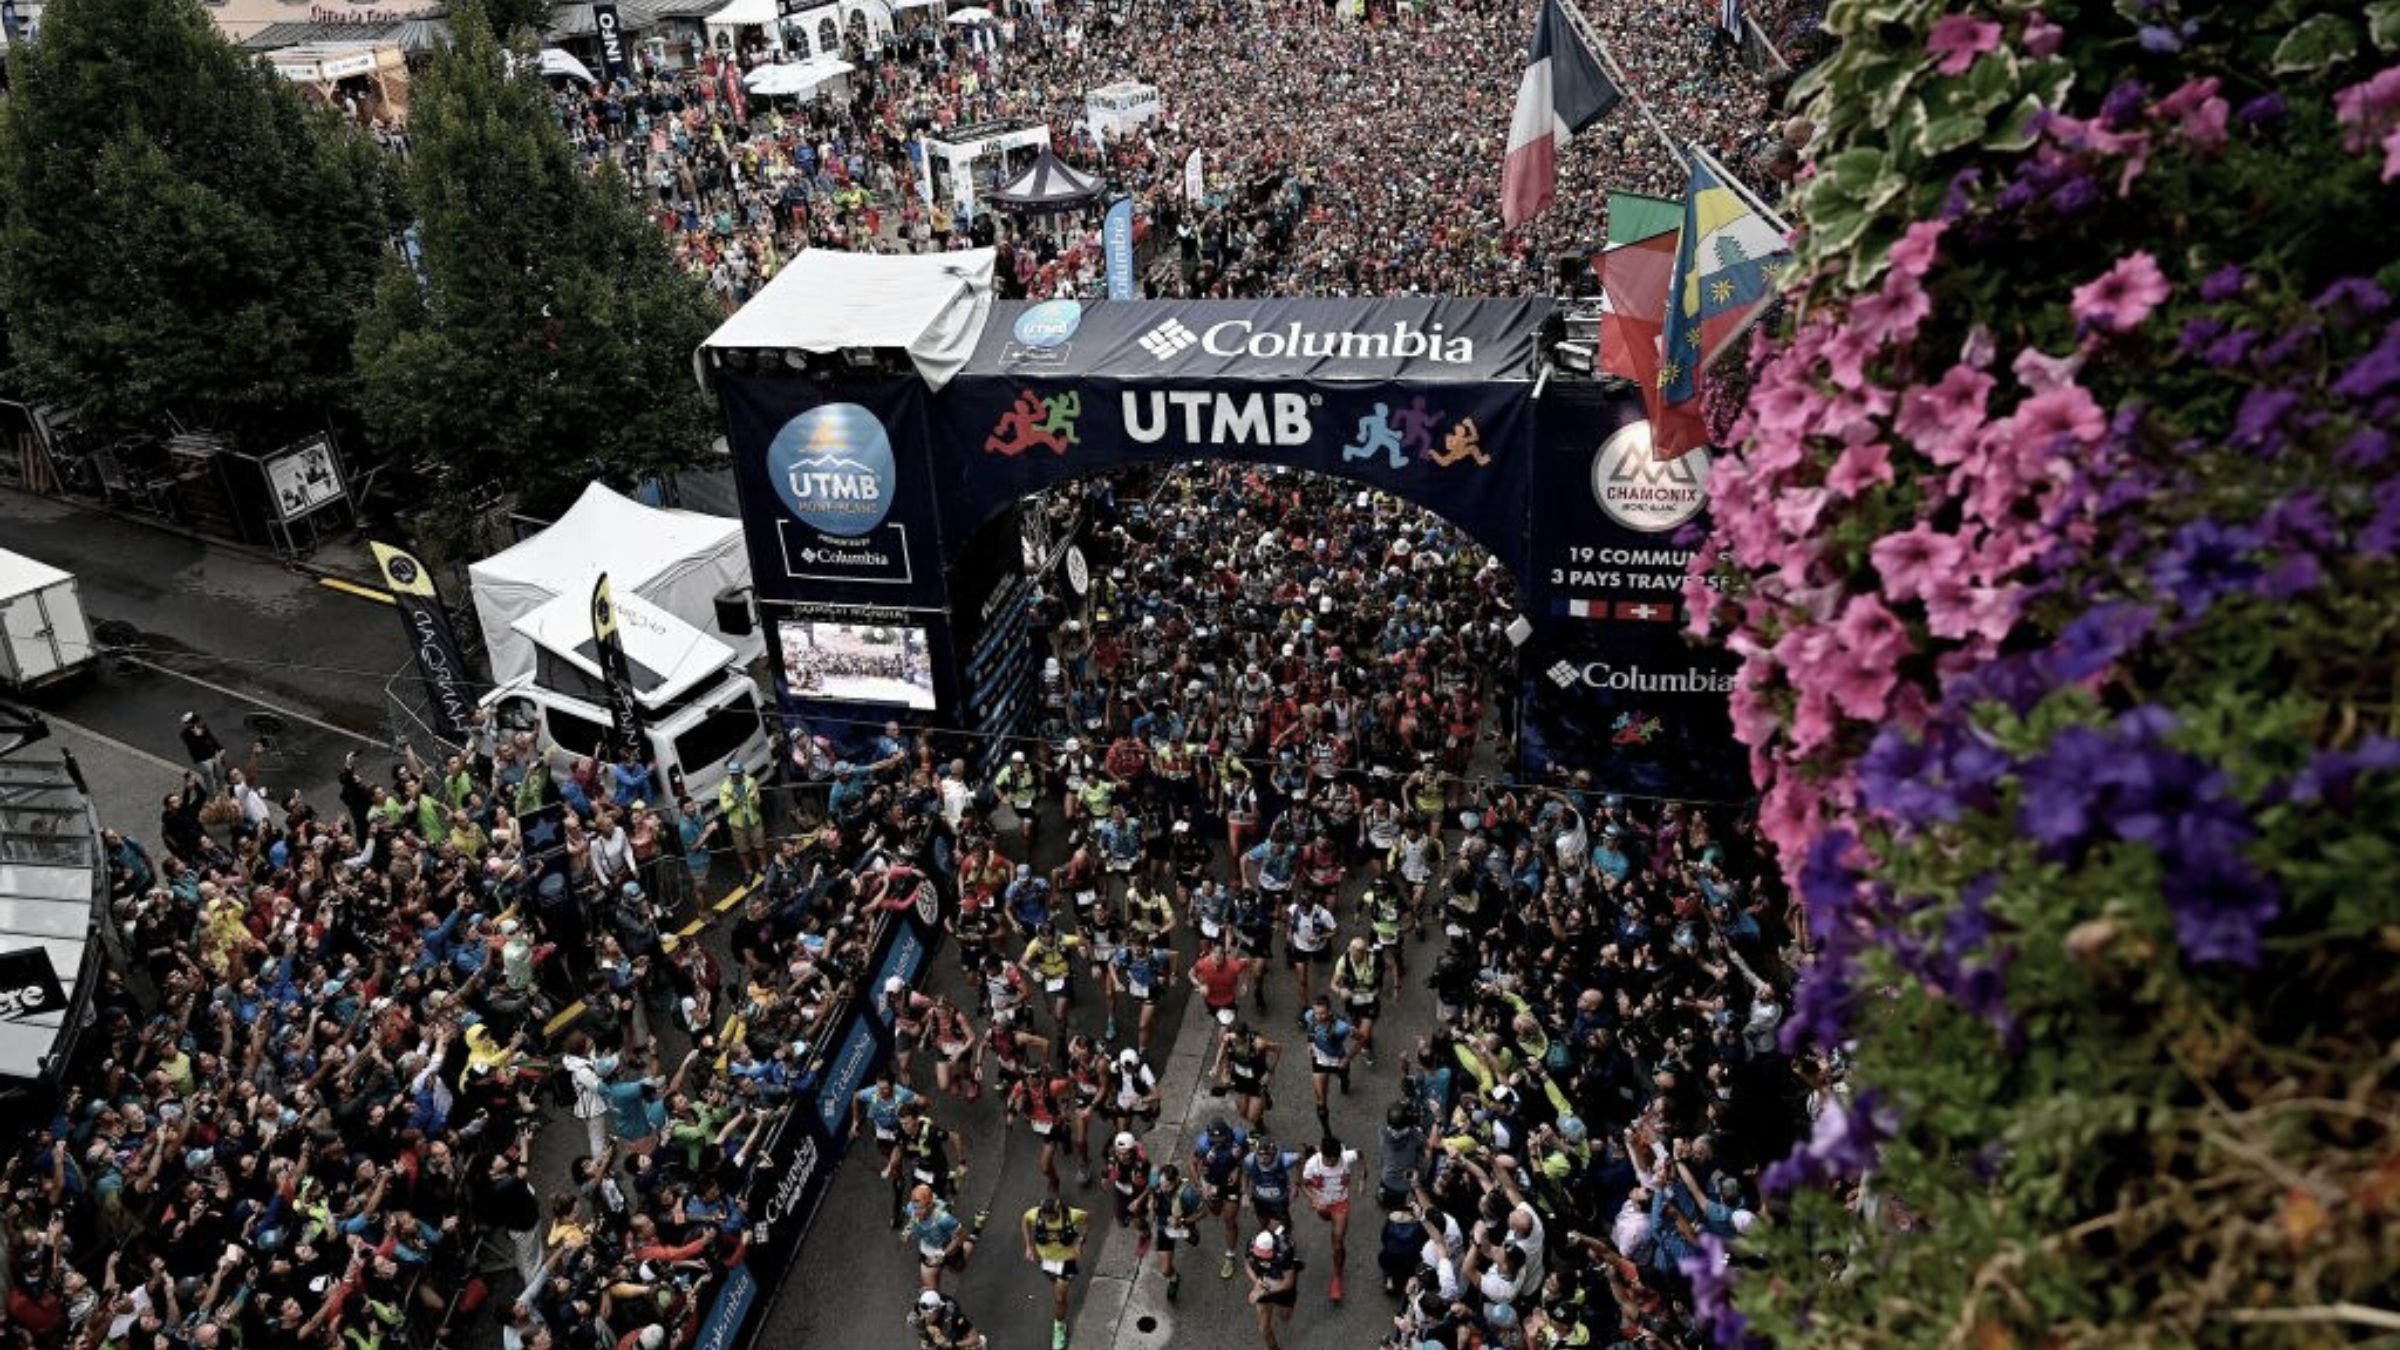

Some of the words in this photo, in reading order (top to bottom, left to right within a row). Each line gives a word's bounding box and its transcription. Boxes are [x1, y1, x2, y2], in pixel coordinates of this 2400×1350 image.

[599, 12, 623, 63] INFO
[1201, 319, 1473, 363] Columbia
[788, 472, 880, 501] UTMB
[1606, 486, 1698, 503] CHAMONIX
[816, 547, 889, 566] Columbia
[1569, 546, 1595, 562] 19
[1550, 568, 1565, 585] 3
[1570, 570, 1621, 588] PAYS
[1581, 661, 1736, 693] Columbia
